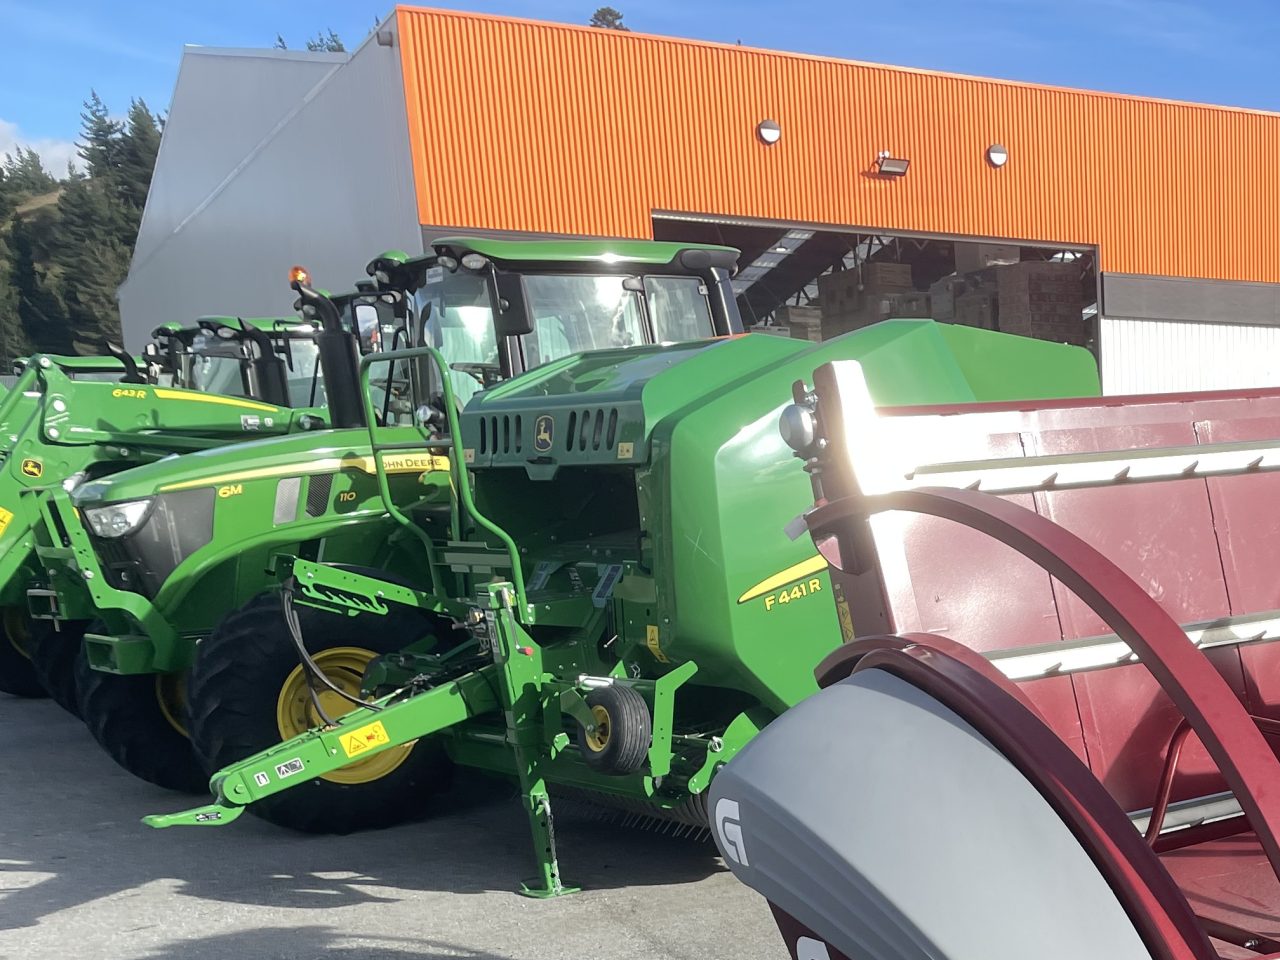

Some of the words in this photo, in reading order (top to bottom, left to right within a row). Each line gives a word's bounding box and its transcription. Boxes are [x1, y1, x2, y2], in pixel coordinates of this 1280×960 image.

[405, 458, 442, 468] DEERE
[218, 484, 243, 498] 6M
[339, 491, 357, 502] 110
